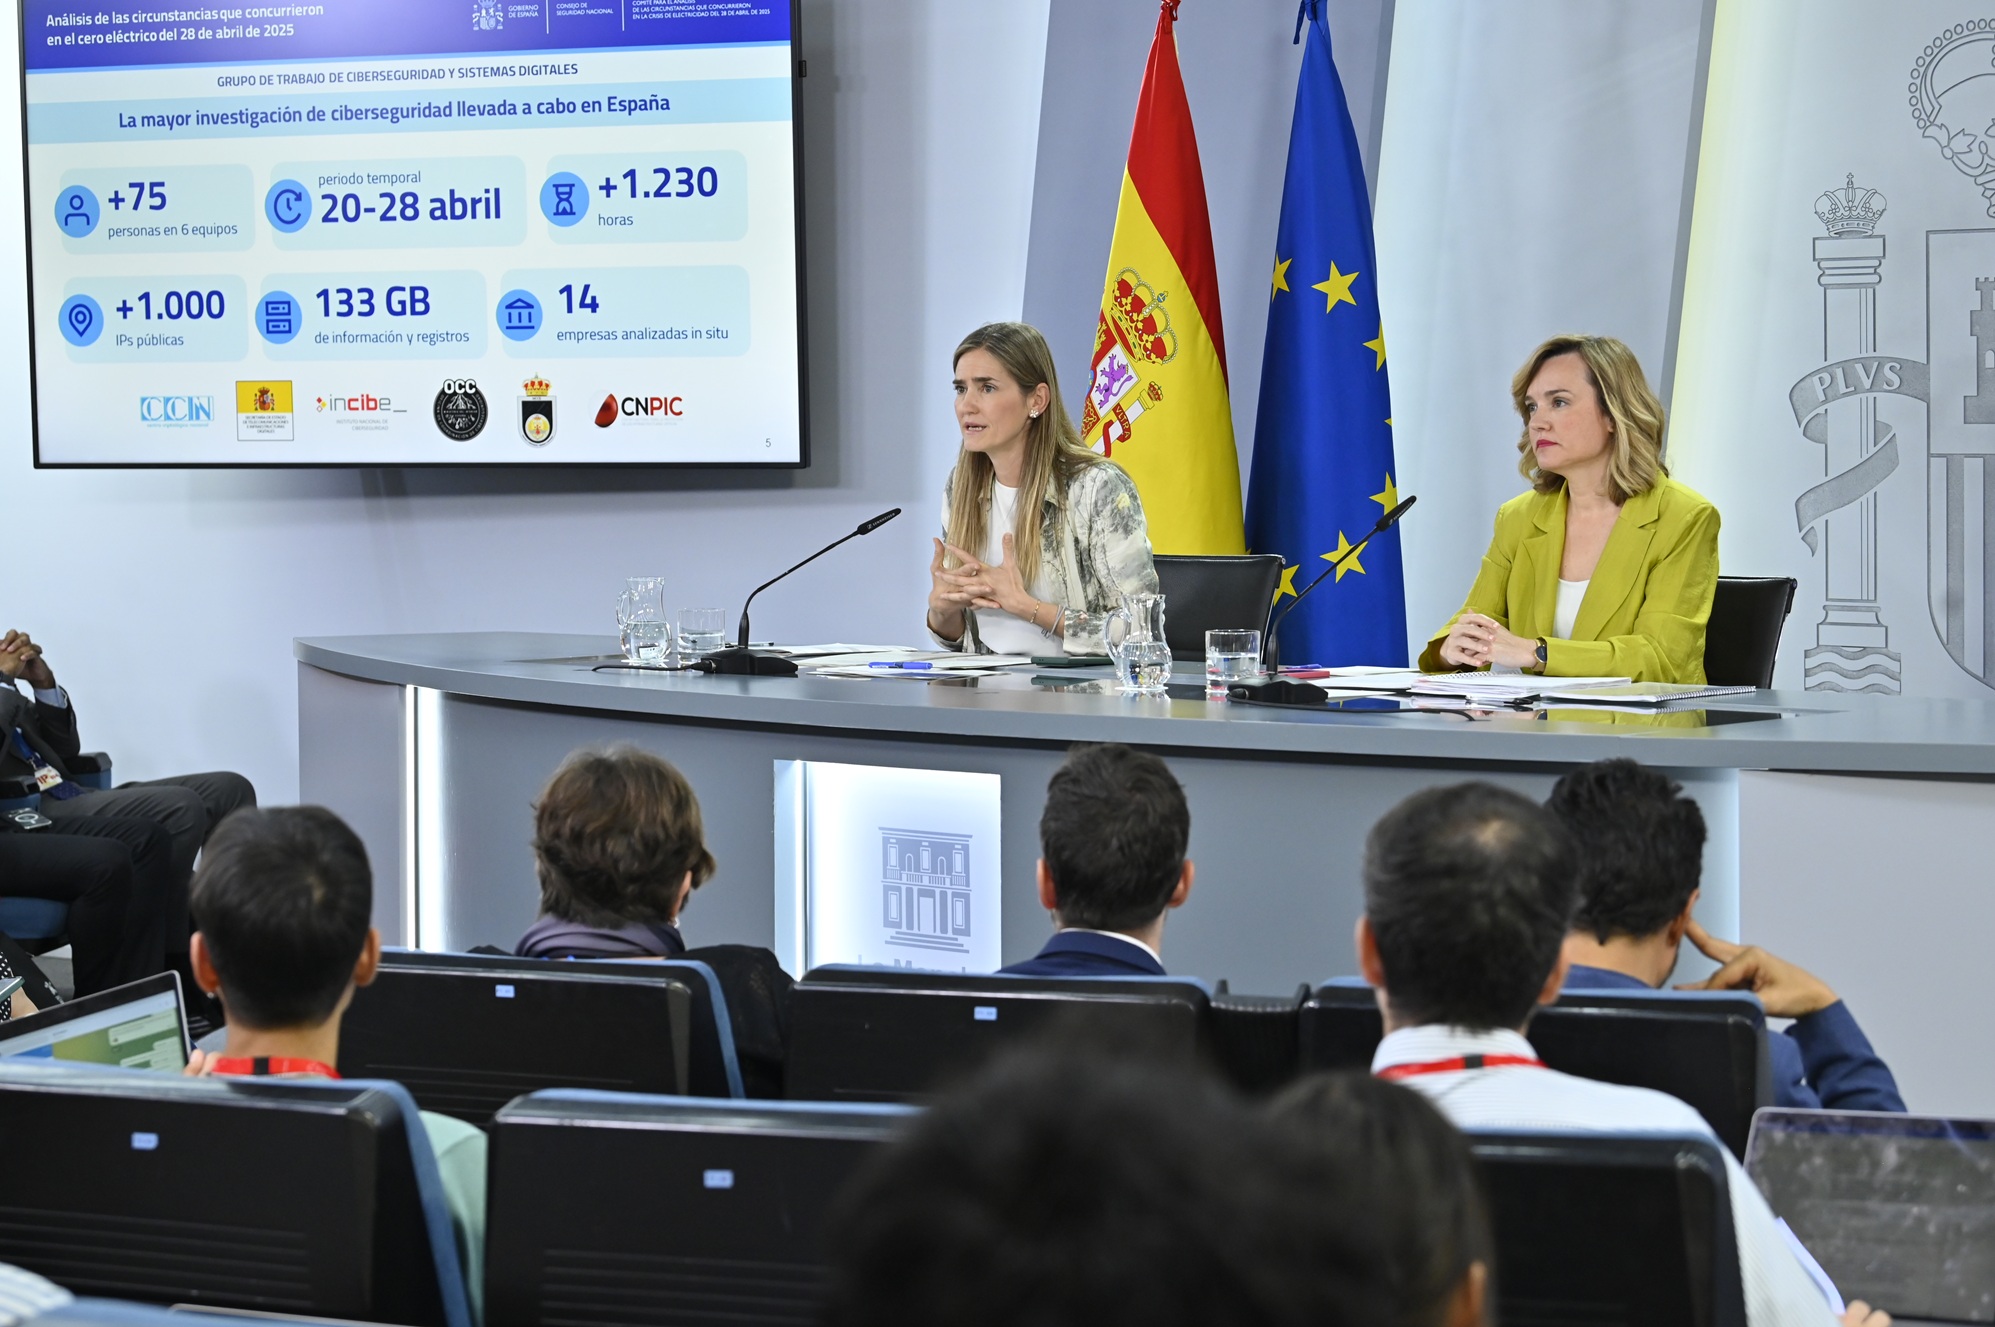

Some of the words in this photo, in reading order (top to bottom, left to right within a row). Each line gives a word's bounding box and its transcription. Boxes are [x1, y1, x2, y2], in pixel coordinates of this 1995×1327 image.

[46, 13, 92, 27] Análisis
[94, 12, 109, 25] de
[112, 11, 130, 24] las
[132, 8, 218, 23] circunstancias
[220, 9, 242, 22] que
[245, 4, 324, 18] concurrieron
[517, 10, 539, 18] ESPAÑA
[46, 35, 62, 46] en
[64, 32, 75, 45] el
[77, 34, 104, 45] cero
[105, 29, 157, 43] eléctrico
[159, 28, 177, 41] del
[180, 28, 195, 40] 28
[198, 26, 213, 39] de
[216, 25, 243, 39] abril
[245, 25, 260, 38] de
[263, 23, 294, 37] 2025
[217, 75, 256, 87] GRUPO
[259, 74, 274, 85] DE
[276, 72, 326, 85] TRABAJO
[329, 71, 344, 83] DE
[346, 67, 446, 83] CIBERSEGURIDAD
[448, 68, 455, 78] Y
[457, 65, 516, 78] SISTEMAS
[518, 63, 578, 77] DIGITALES
[119, 112, 137, 128] La
[141, 112, 191, 131] mayor
[196, 106, 303, 129] investigación
[306, 105, 326, 122] de
[331, 101, 452, 125] ciberseguridad
[457, 99, 518, 118] llevada
[522, 102, 532, 115] a
[537, 98, 577, 115] cabo
[581, 100, 602, 113] en
[607, 93, 671, 116] España
[318, 172, 364, 188] periodo
[367, 170, 421, 187] temporal
[598, 165, 719, 199] +1.230
[108, 180, 167, 211] +75
[320, 190, 420, 223] 20-28
[429, 187, 501, 220] abril
[108, 225, 161, 239] personas
[163, 225, 178, 236] en
[181, 222, 190, 235] 6
[192, 221, 238, 237] equipos
[598, 212, 634, 226] horas
[116, 289, 226, 321] +1.000
[315, 286, 375, 318] 133
[385, 285, 431, 317] GB
[558, 283, 600, 314] 14
[115, 333, 134, 347] IPs
[137, 331, 184, 349] públicas
[314, 331, 329, 344] de
[332, 330, 403, 344] información
[407, 333, 414, 346] y
[416, 329, 470, 345] registros
[557, 328, 618, 343] empresas
[621, 325, 688, 341] analizadas
[691, 326, 702, 340] in
[705, 326, 729, 339] situ
[444, 380, 476, 395] OCC
[1812, 361, 1902, 403] PLVS
[141, 396, 214, 421] CCN
[621, 396, 683, 416] CNPIC
[1116, 405, 1131, 439] VLTRA
[765, 438, 772, 448] 5
